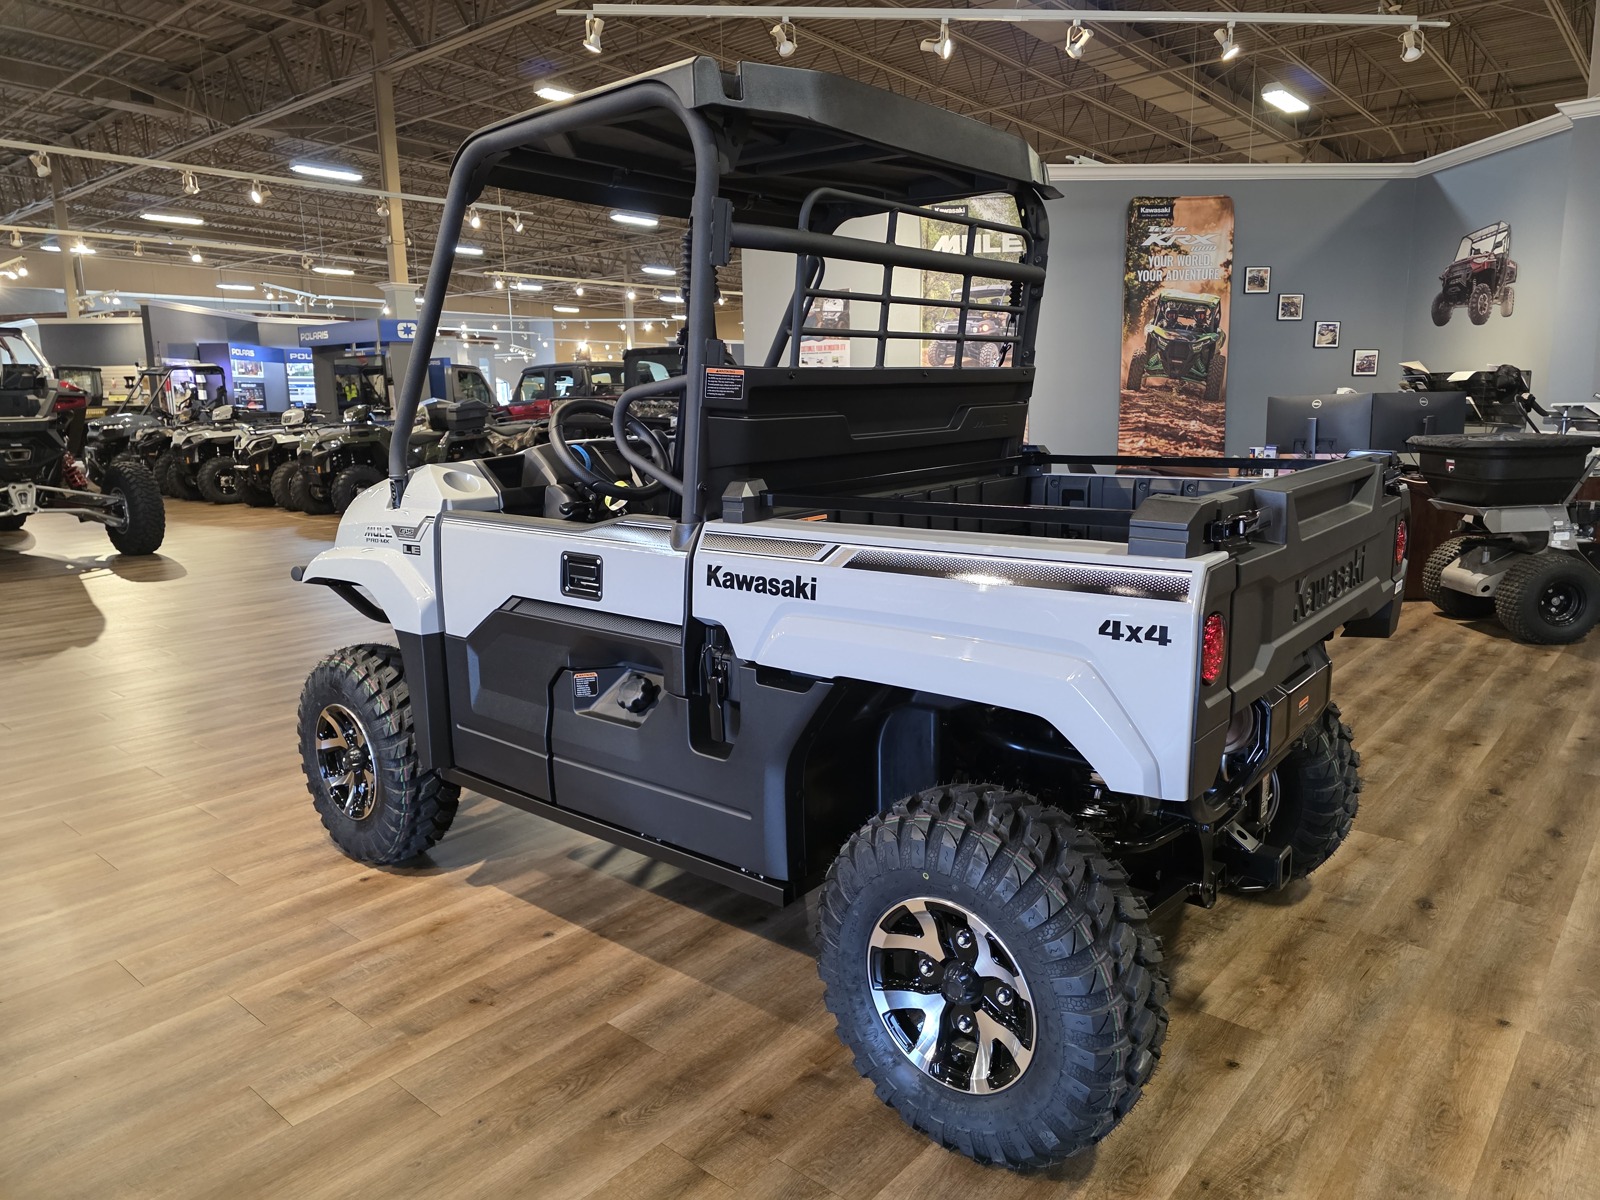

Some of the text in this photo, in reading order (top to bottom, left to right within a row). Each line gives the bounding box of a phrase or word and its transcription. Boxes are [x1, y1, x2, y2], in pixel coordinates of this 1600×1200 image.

[1141, 233, 1220, 246] KRX
[1148, 254, 1212, 268] YOUR WORLD.
[1137, 268, 1222, 282] YOUR ADVENTURE.
[300, 330, 329, 342] POLARIS
[231, 348, 255, 357] POLARIS
[364, 526, 393, 538] MULE
[403, 544, 421, 556] LE
[706, 564, 818, 601] Kawasaki
[1292, 544, 1366, 624] Kawasaki
[1098, 619, 1172, 647] 4x4
